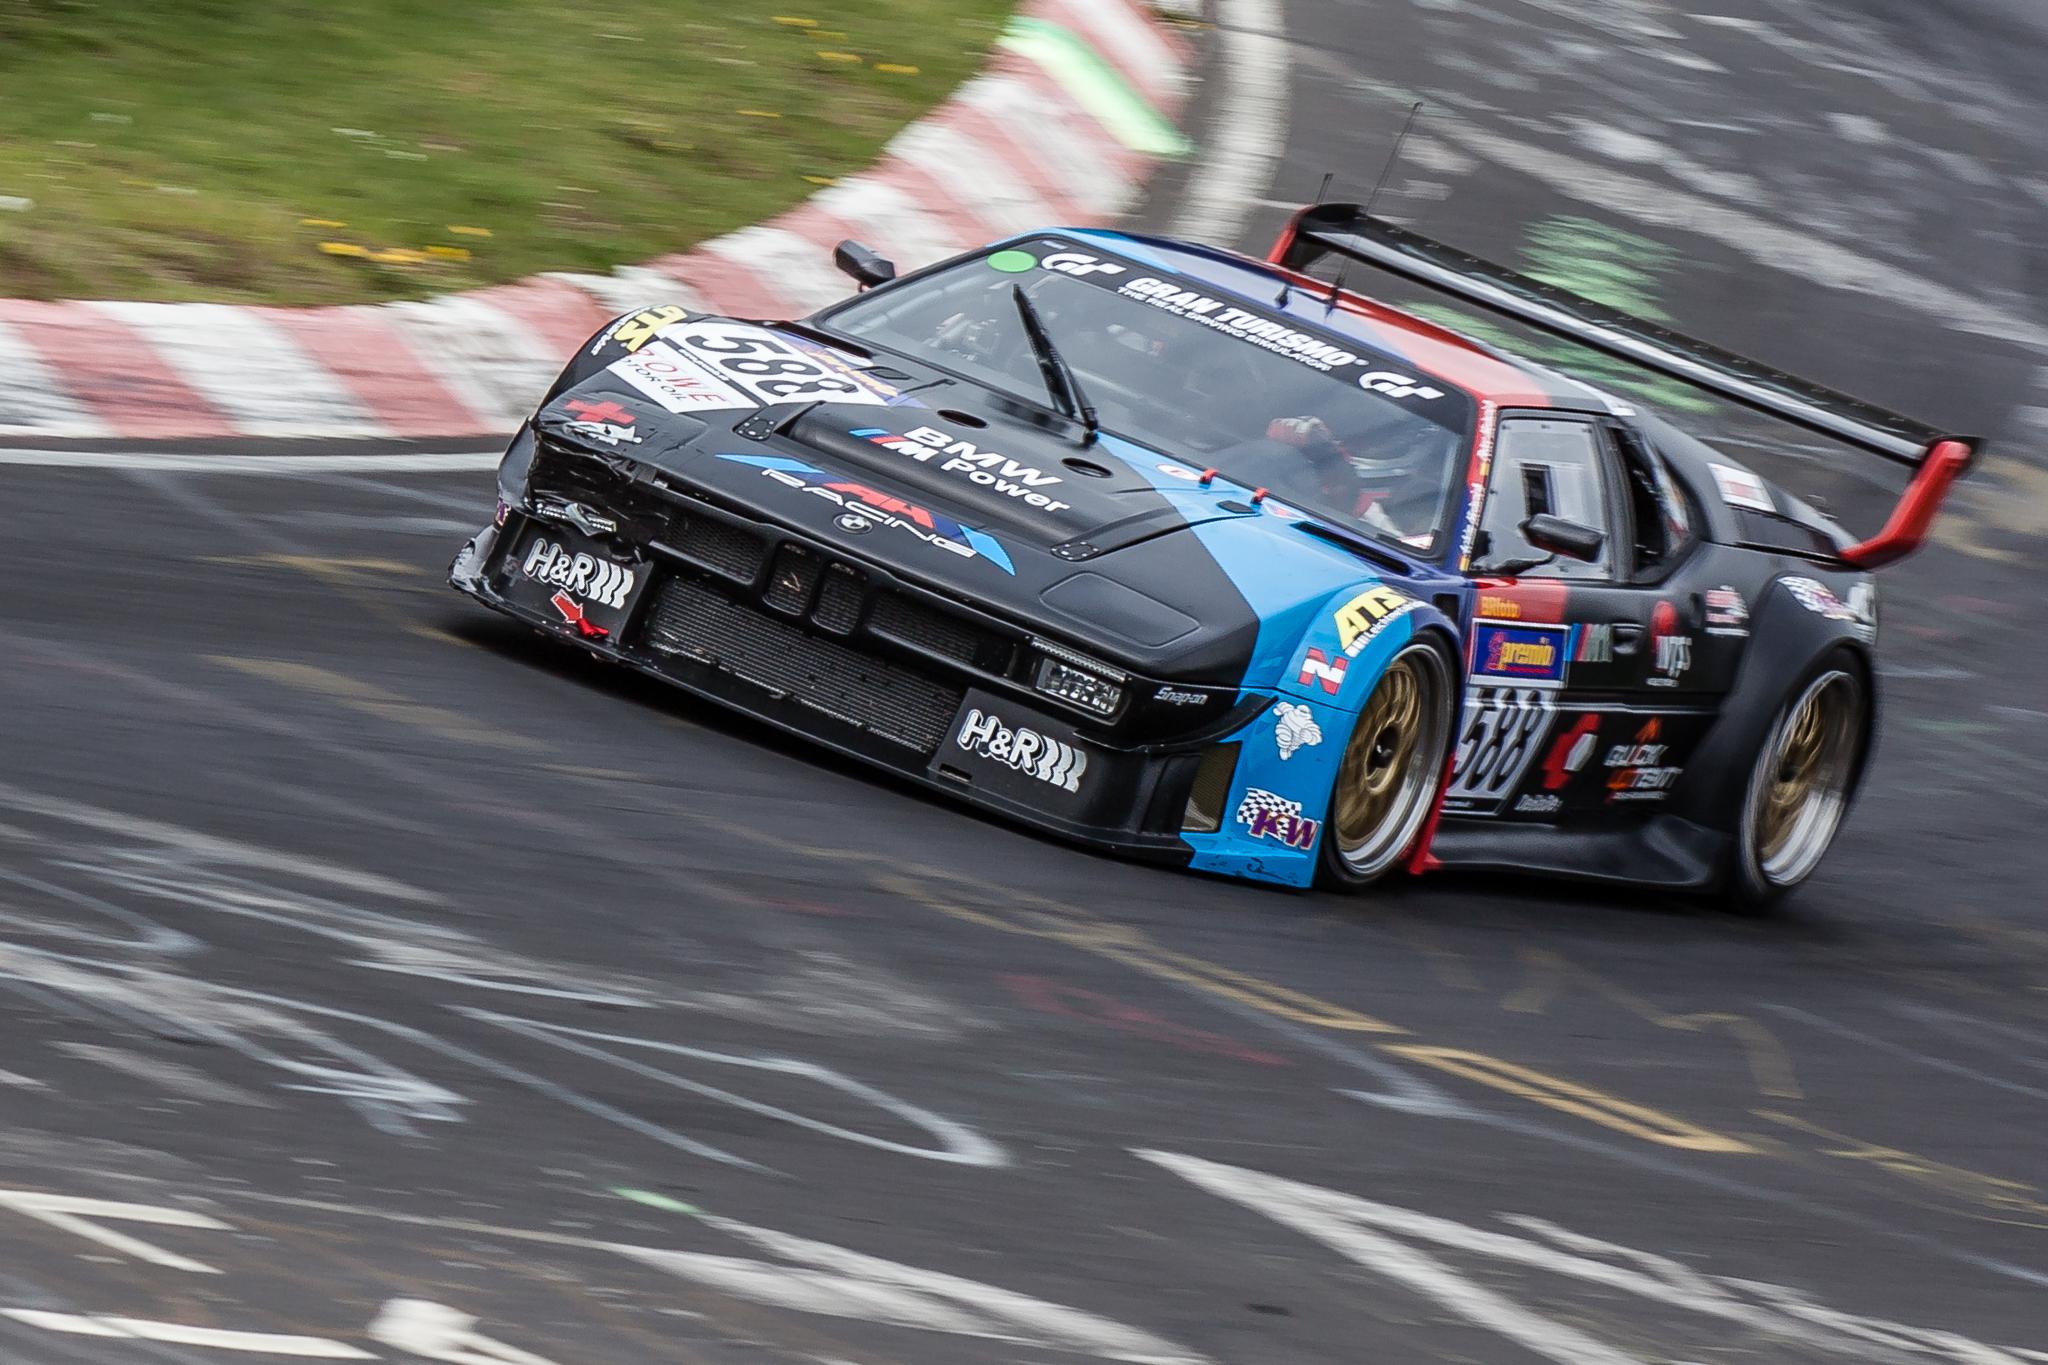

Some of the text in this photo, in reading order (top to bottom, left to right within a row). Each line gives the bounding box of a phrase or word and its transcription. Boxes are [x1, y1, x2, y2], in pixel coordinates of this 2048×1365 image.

[1117, 286, 1334, 372] THE REAL DRIVING SIMULATOR
[1124, 277, 1359, 367] GRAN TURISMO
[685, 334, 859, 397] 588
[903, 426, 1063, 487] BMW
[940, 457, 1071, 513] Power
[761, 468, 978, 559] RACING
[523, 538, 598, 597] H&R
[1153, 686, 1209, 706] Snap-on
[957, 708, 1045, 777] H&R
[1449, 687, 1543, 793] 588
[1247, 807, 1321, 851] KW
